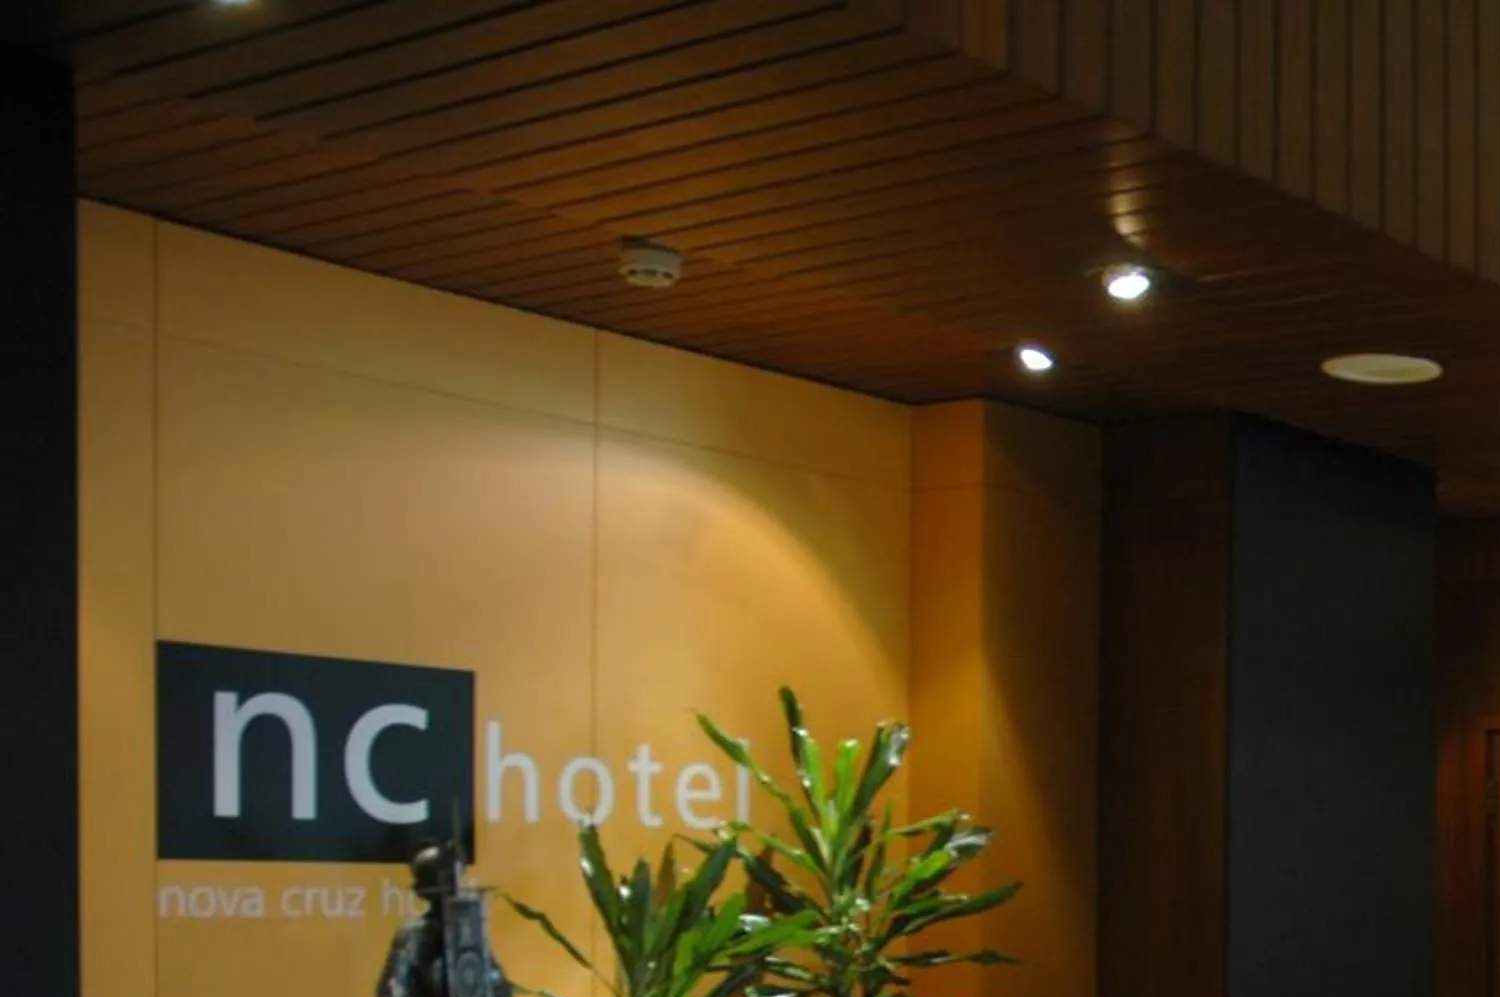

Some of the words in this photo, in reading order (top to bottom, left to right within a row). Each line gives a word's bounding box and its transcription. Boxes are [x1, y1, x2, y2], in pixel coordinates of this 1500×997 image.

[213, 690, 429, 825] nc
[487, 720, 750, 829] hotel
[159, 884, 266, 918] nova
[281, 885, 367, 918] cruz
